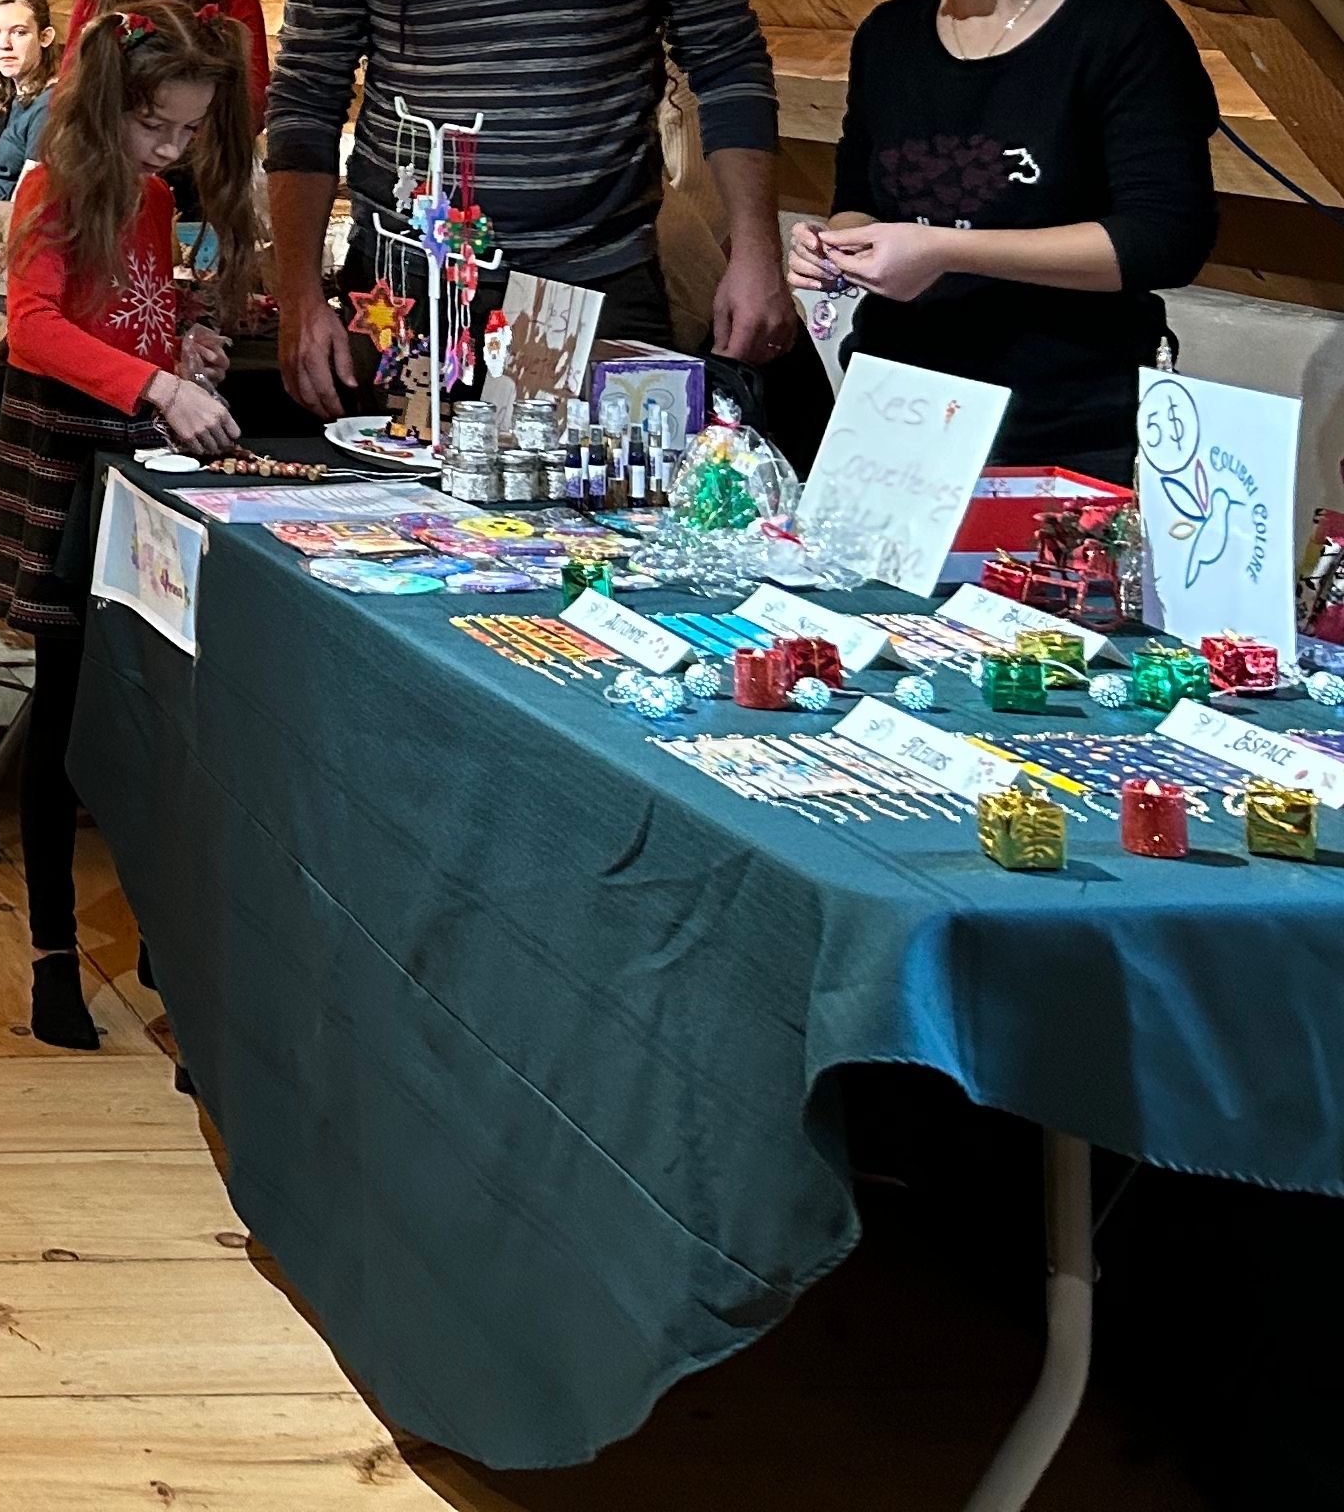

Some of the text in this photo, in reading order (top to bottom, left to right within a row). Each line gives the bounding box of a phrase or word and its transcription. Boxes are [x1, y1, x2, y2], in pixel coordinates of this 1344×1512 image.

[864, 368, 930, 426] Les
[1209, 445, 1259, 498] COLIBRI
[1223, 728, 1298, 767] ESPACE
